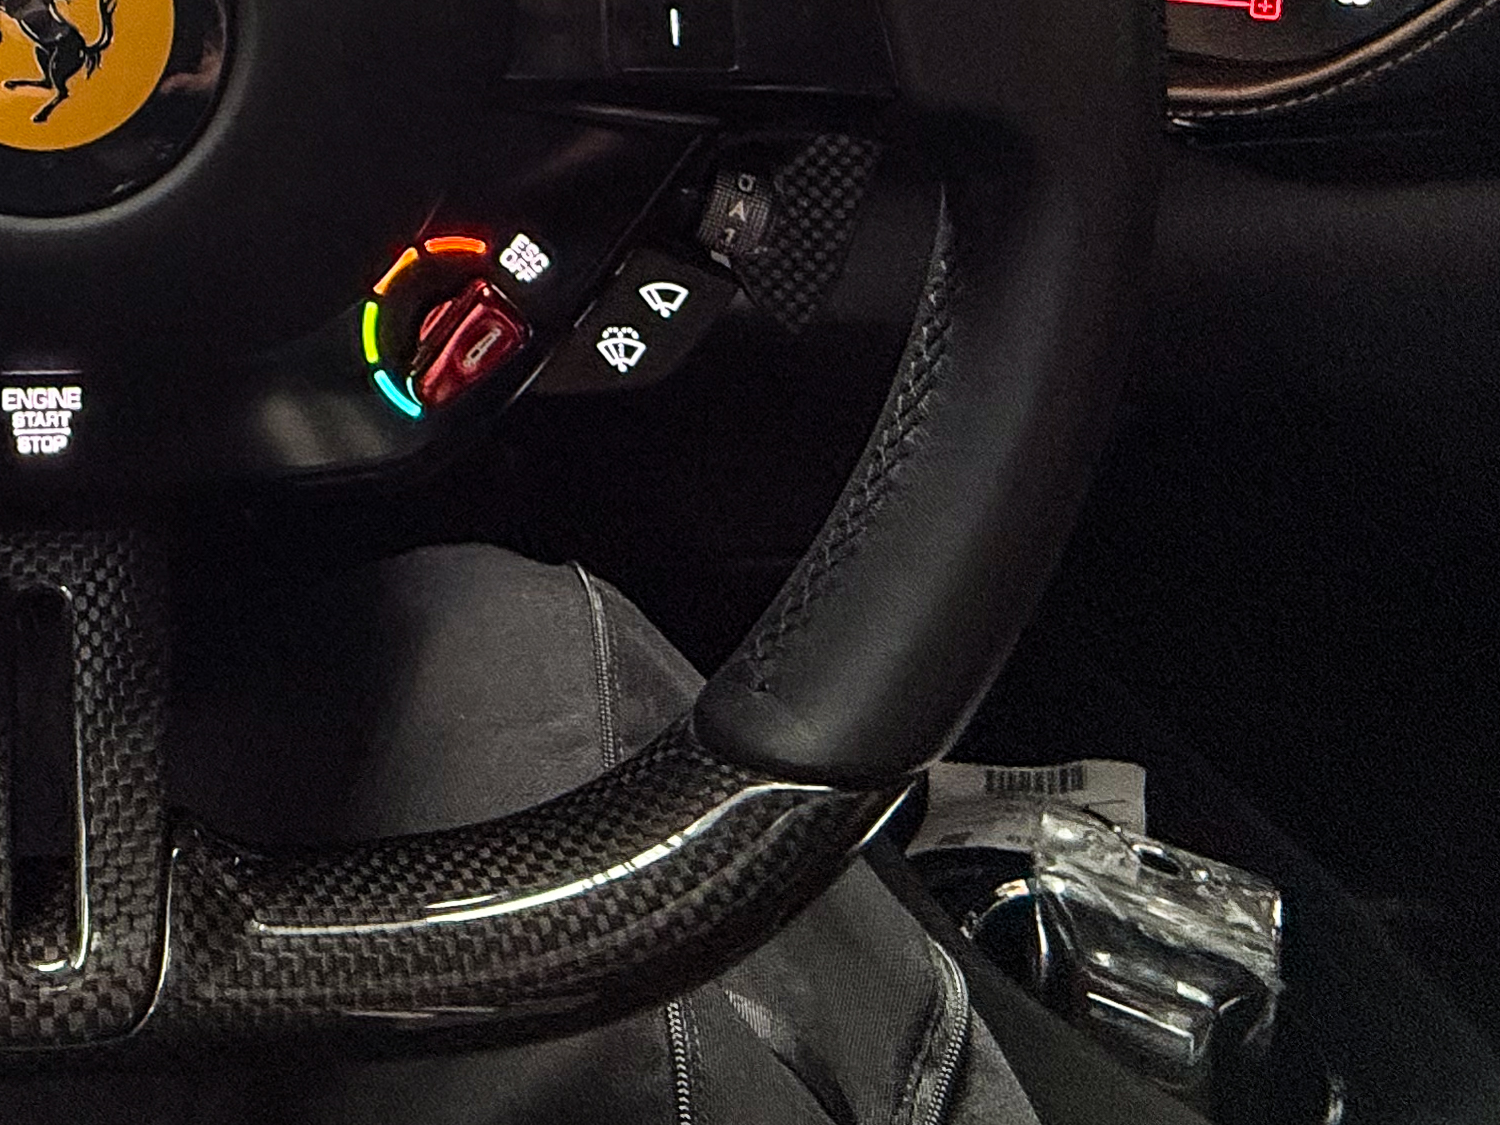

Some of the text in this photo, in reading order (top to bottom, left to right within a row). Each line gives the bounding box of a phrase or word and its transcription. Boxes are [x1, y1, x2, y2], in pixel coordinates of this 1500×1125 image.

[1, 386, 82, 411] ENGINE
[11, 410, 72, 428] START
[16, 435, 68, 454] STOP
